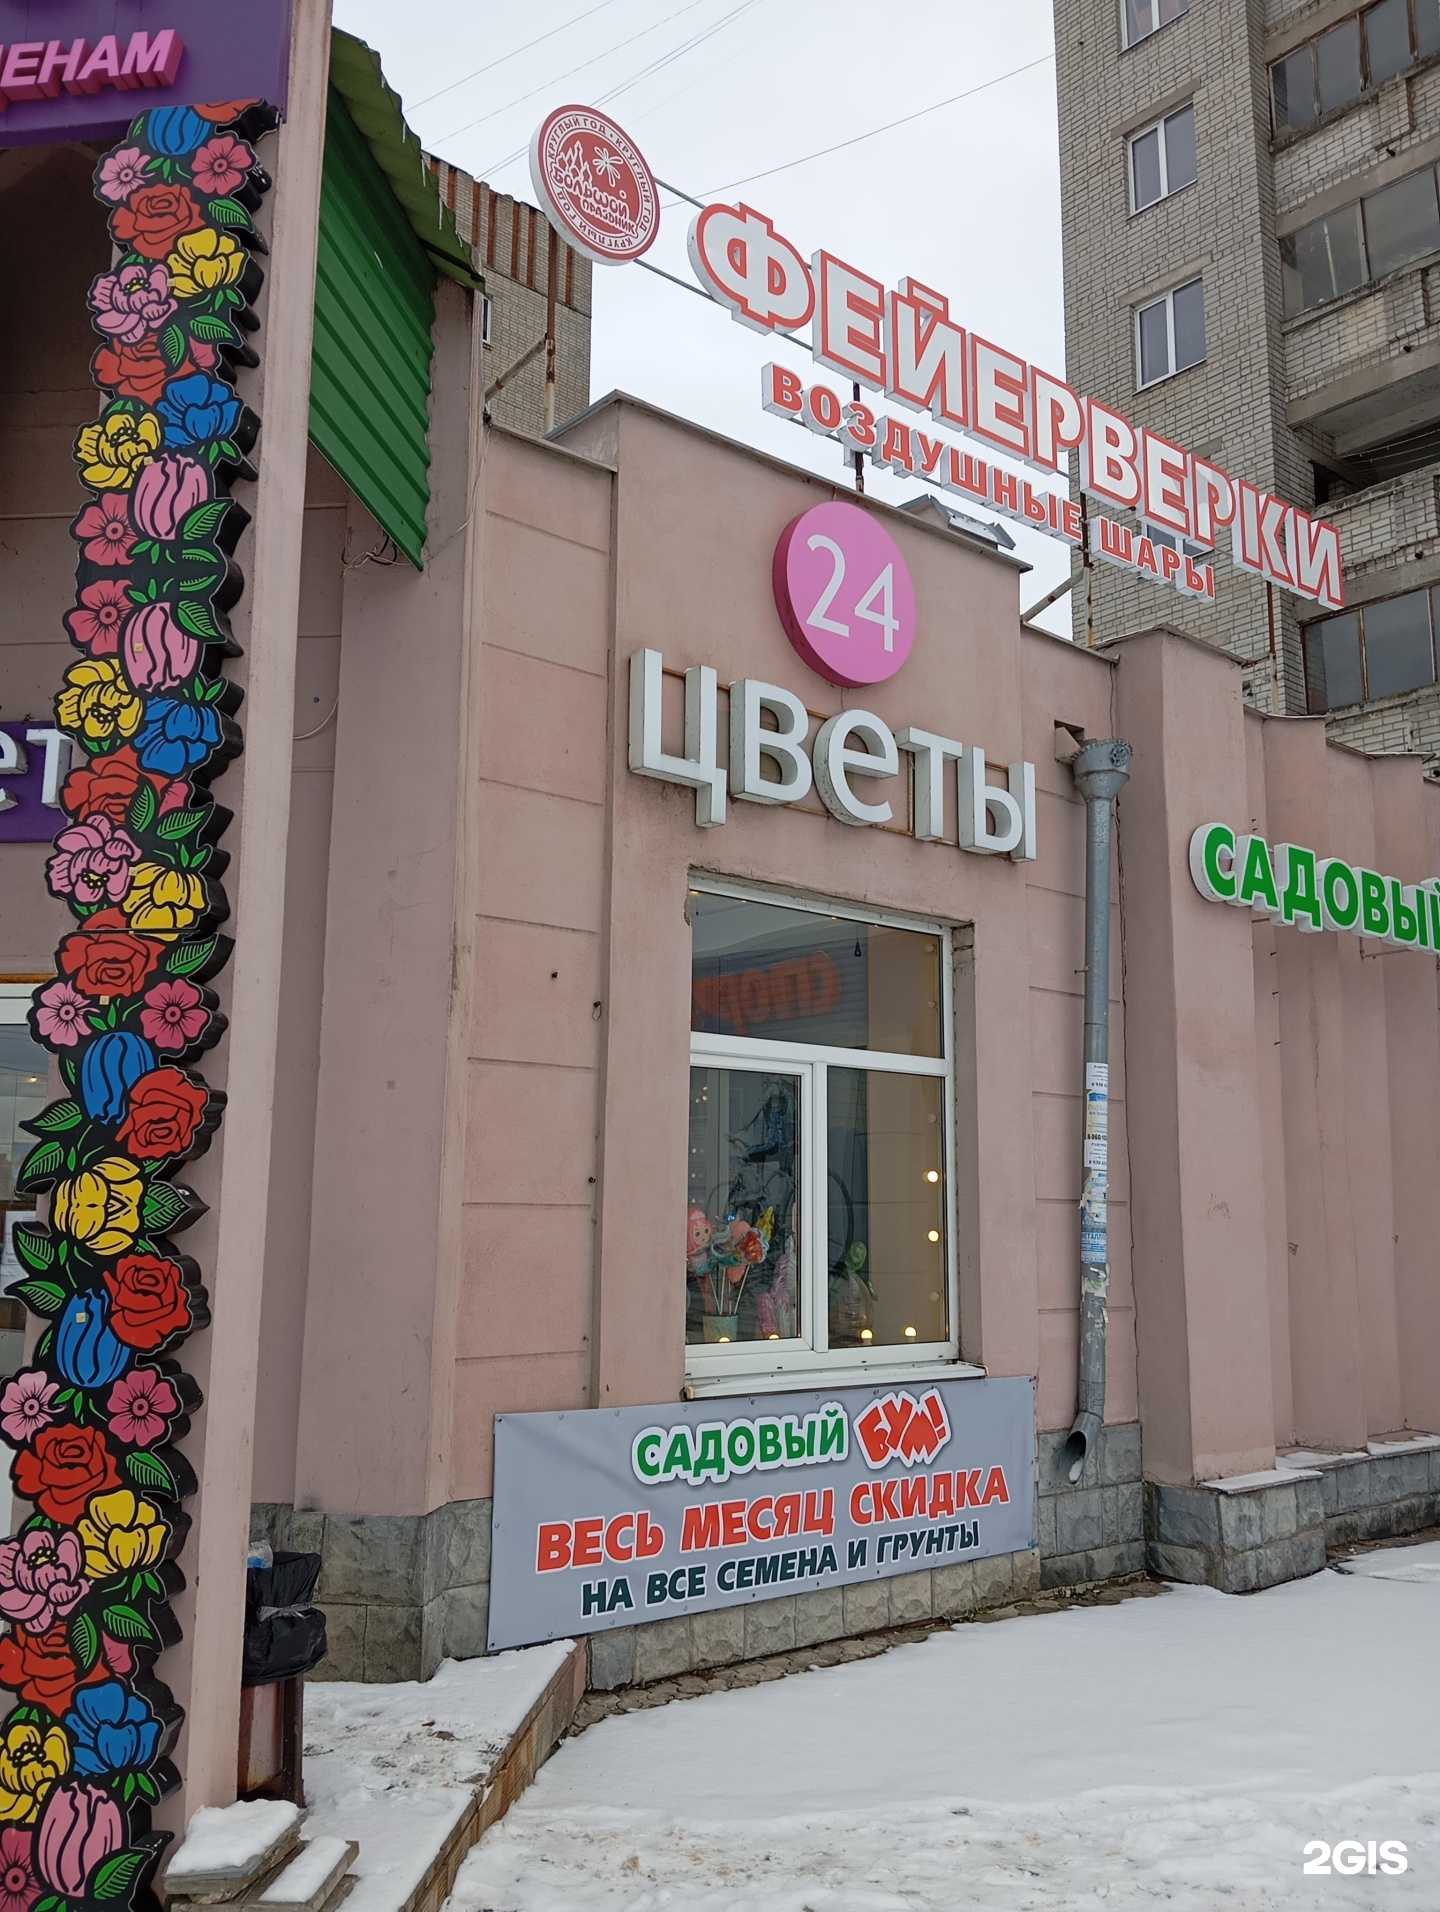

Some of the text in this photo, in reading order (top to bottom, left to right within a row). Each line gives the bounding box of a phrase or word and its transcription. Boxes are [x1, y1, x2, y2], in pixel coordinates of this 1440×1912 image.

[0, 29, 182, 98] ЕНАМ
[548, 115, 607, 161] КРУГЛЫЙ ГОД
[551, 165, 630, 220] БОЛЬШОЙ
[556, 191, 577, 221] ГОД
[581, 199, 637, 236] ПРАЗДНИК
[615, 138, 652, 233] КРУГЛЫЙ ГОД
[689, 202, 1345, 610] ФЕЙЕРВЕРКИ
[763, 361, 1216, 600] ВОЗДУШНЫЕ ШАРЫ
[806, 533, 900, 653] 24
[634, 1389, 950, 1482] САДОВЫЙ БУМ!
[536, 1466, 1010, 1573] ВЕСЬ МЕСЯЦ СКИДКА
[582, 1520, 981, 1618] НА ВСЕ СЕМЕНА И ГРУНТЫ
